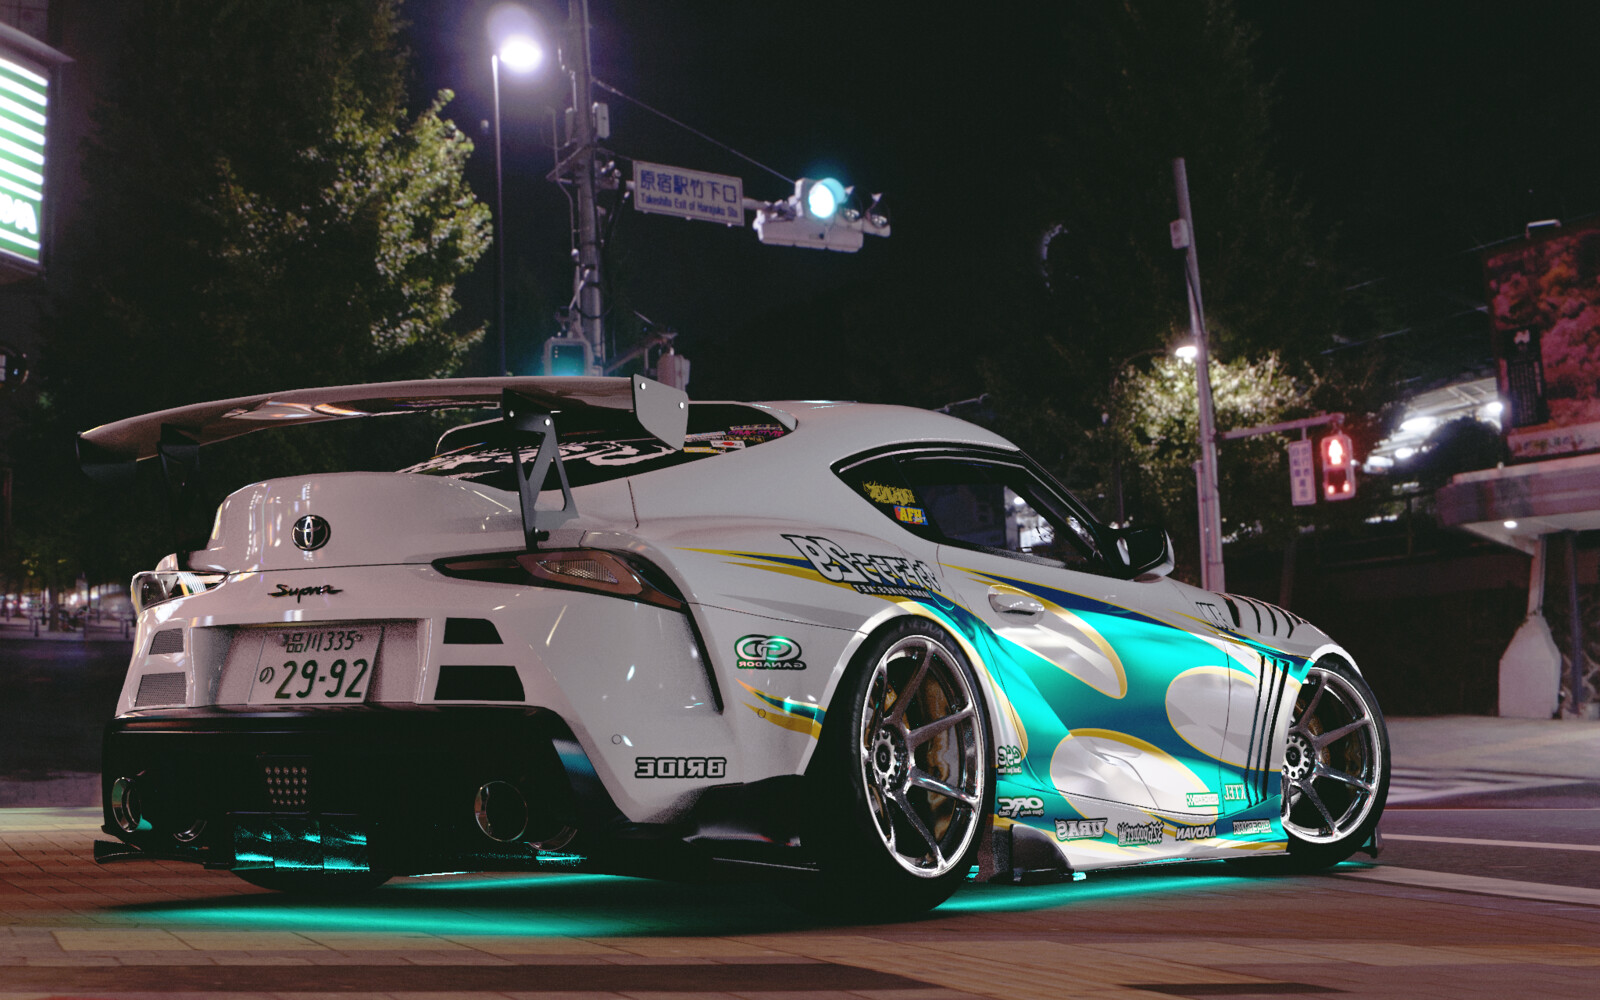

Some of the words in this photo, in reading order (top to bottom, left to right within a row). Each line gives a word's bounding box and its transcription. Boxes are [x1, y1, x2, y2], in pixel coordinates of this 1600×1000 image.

[640, 169, 737, 203] 原宿駅竹下口
[640, 192, 672, 207] Takeshita
[674, 197, 687, 210] Exit
[689, 201, 695, 211] of
[267, 584, 344, 604] Supra
[286, 633, 323, 653] 品川
[323, 631, 357, 651] 335
[259, 666, 274, 685] の
[275, 659, 369, 699] 29-92
